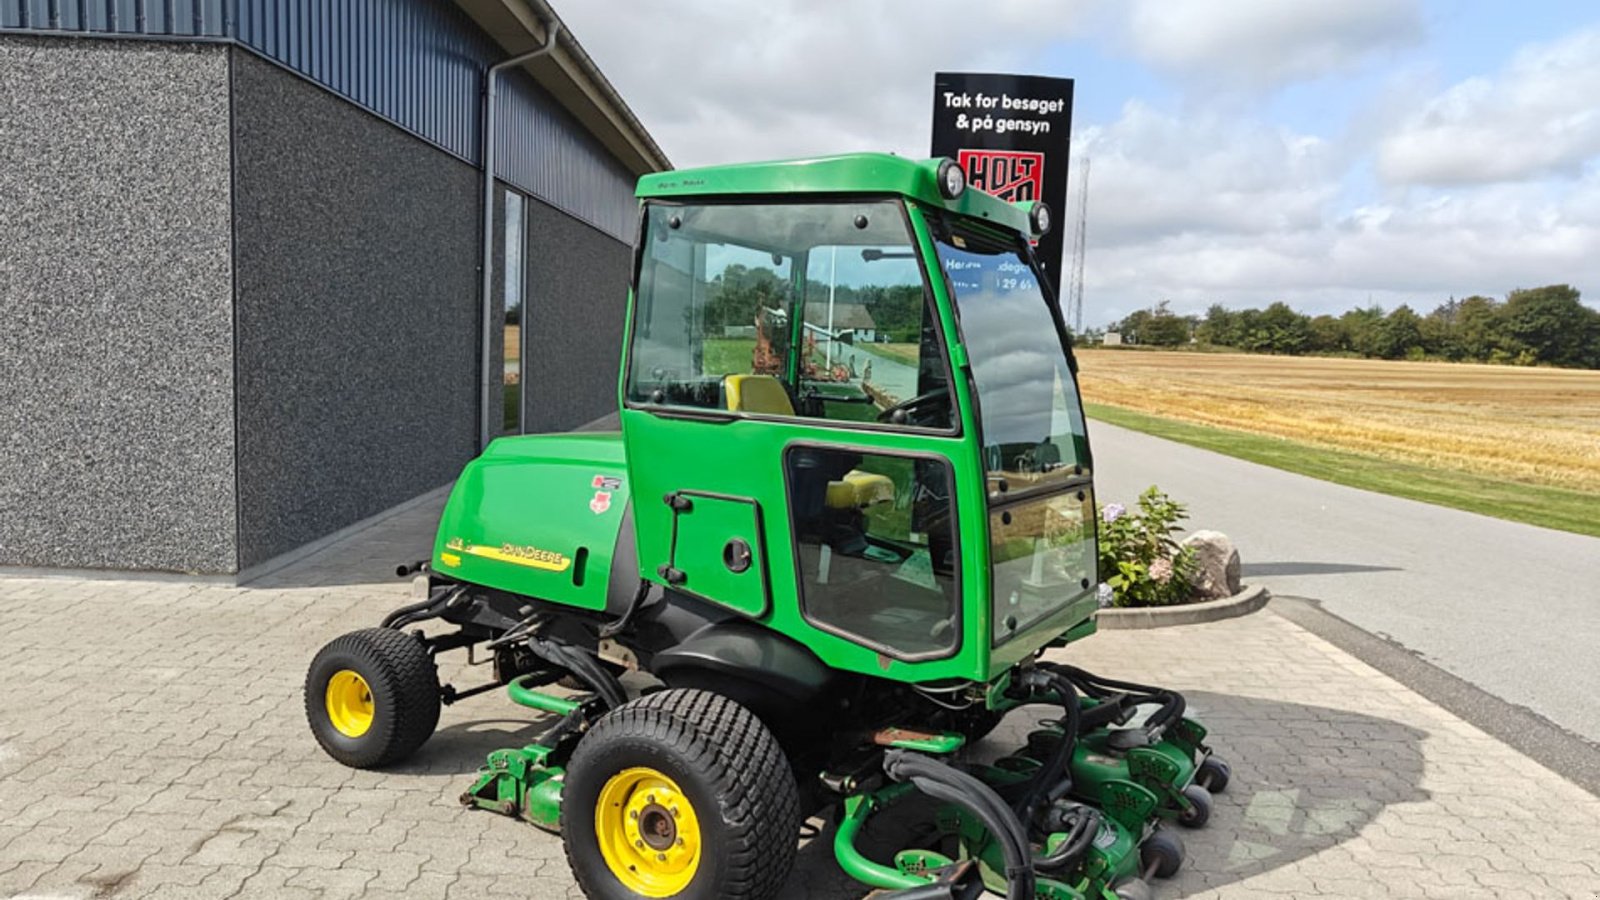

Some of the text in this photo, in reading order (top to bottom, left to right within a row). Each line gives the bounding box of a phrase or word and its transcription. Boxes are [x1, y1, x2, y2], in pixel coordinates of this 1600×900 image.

[943, 92, 1064, 115] Tak for besøget
[956, 113, 1050, 136] & på gensyn
[968, 155, 1037, 192] HOLT
